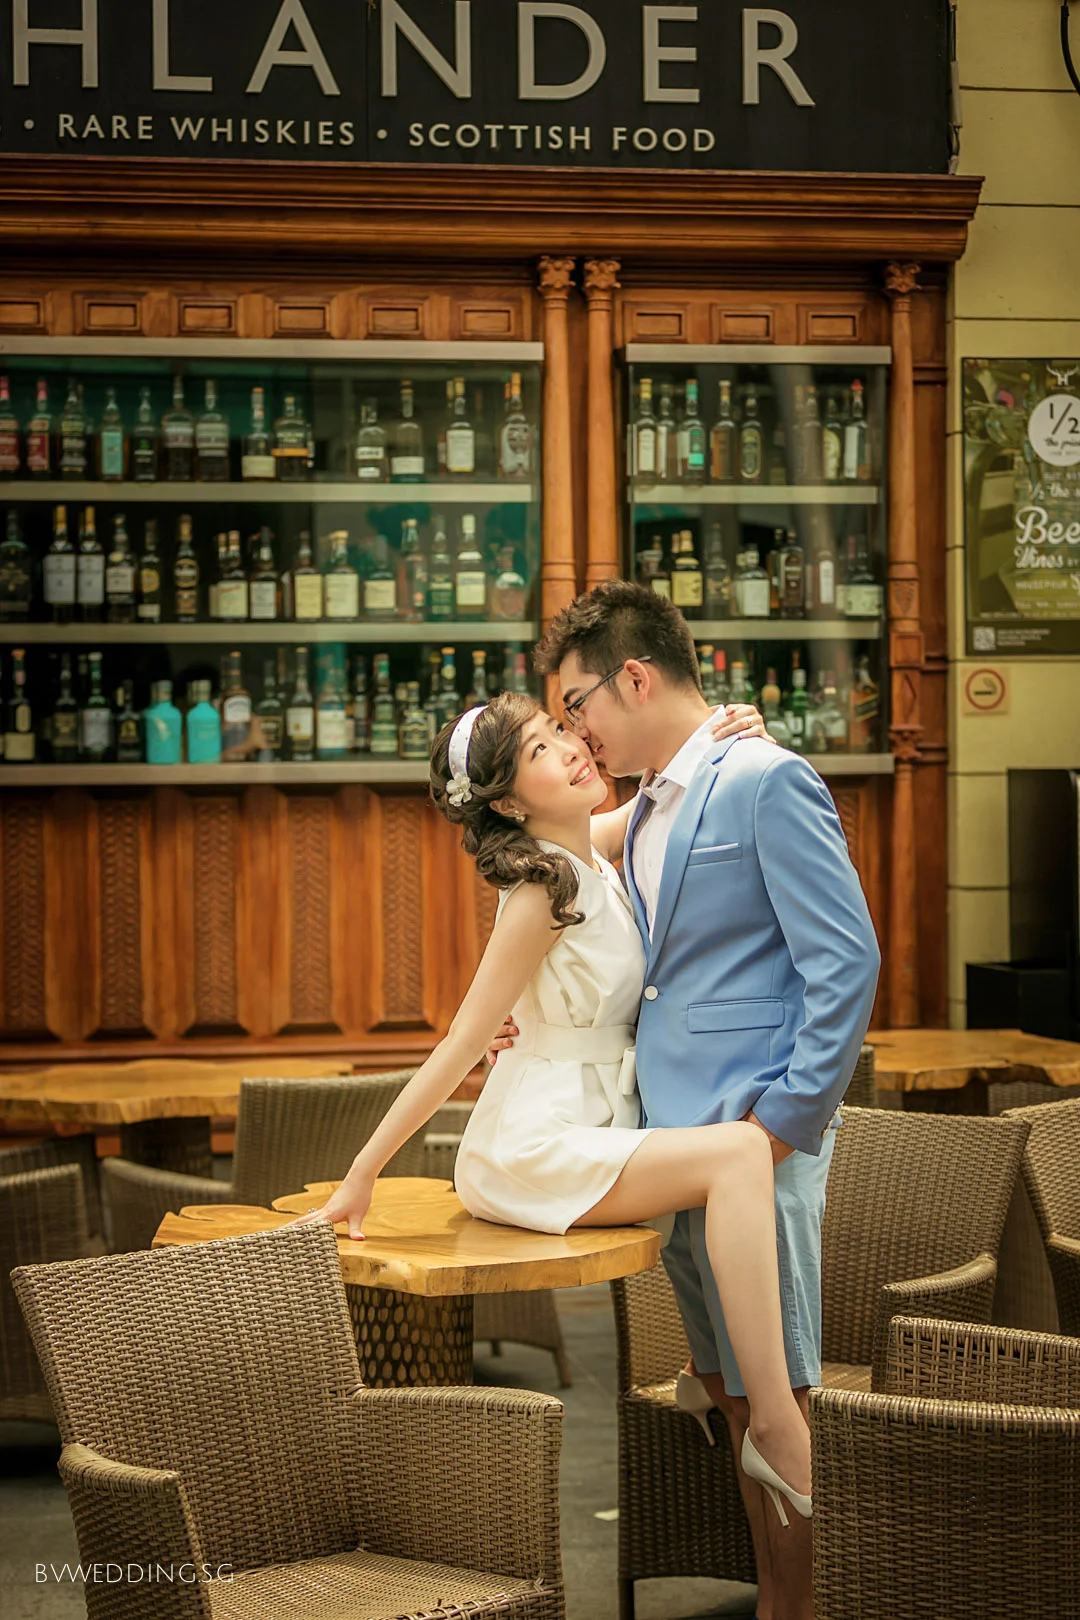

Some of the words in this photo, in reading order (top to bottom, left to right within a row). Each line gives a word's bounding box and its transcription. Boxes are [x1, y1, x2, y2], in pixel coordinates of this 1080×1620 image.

[12, 0, 816, 107] HLANDER
[57, 113, 154, 140] RARE
[169, 116, 355, 146] WHISKIES
[408, 122, 592, 151] SCOTTISH
[612, 127, 717, 153] FOOD
[1013, 545, 1064, 569] Wines
